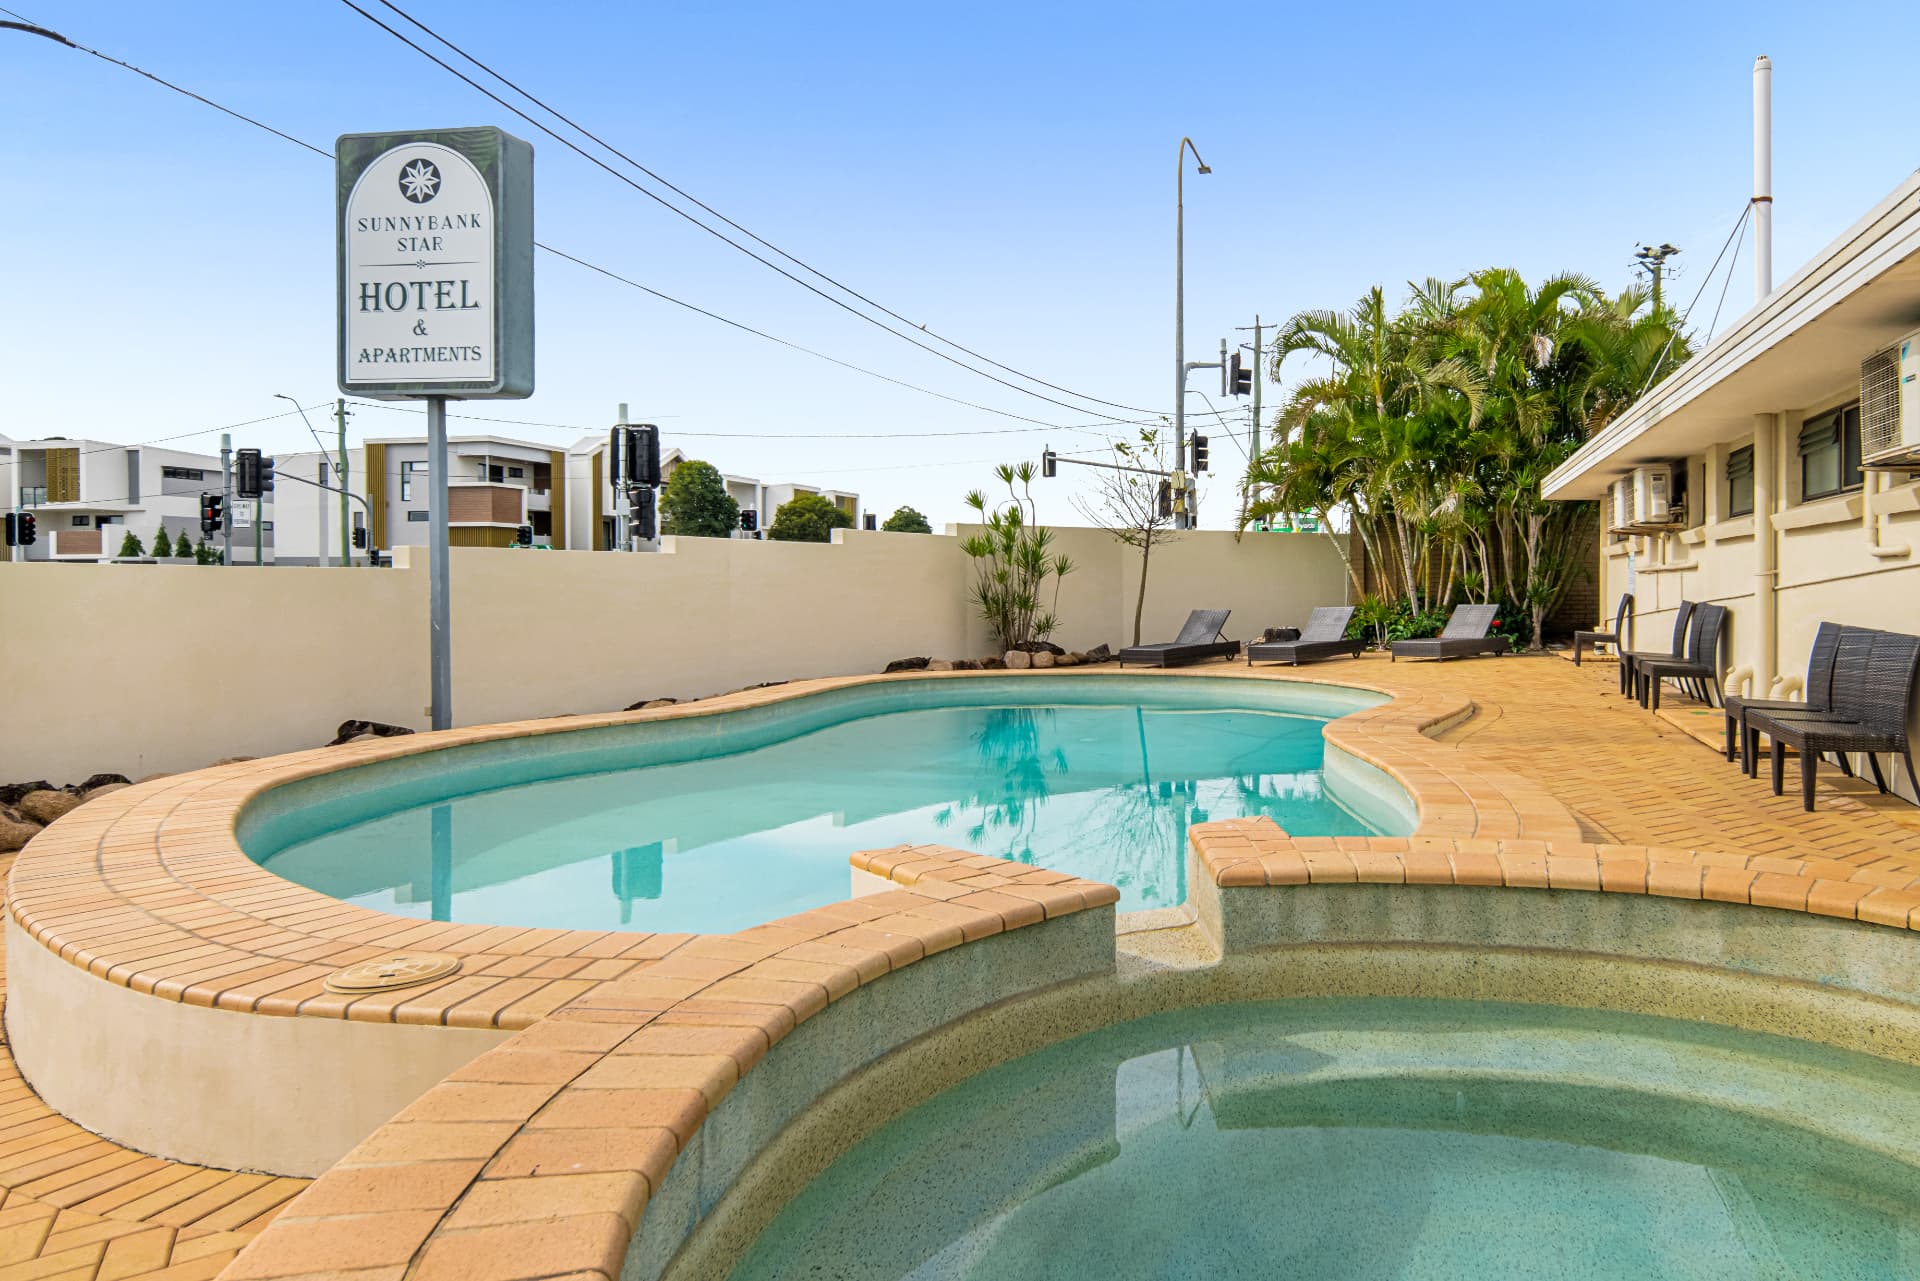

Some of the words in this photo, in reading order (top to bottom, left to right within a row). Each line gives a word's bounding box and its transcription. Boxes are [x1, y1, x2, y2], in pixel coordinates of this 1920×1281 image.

[358, 214, 481, 232] SUNNYBANK
[398, 236, 443, 252] STAR
[358, 279, 480, 312] HOTEL
[412, 318, 428, 336] &
[358, 346, 482, 363] APARTMENTS
